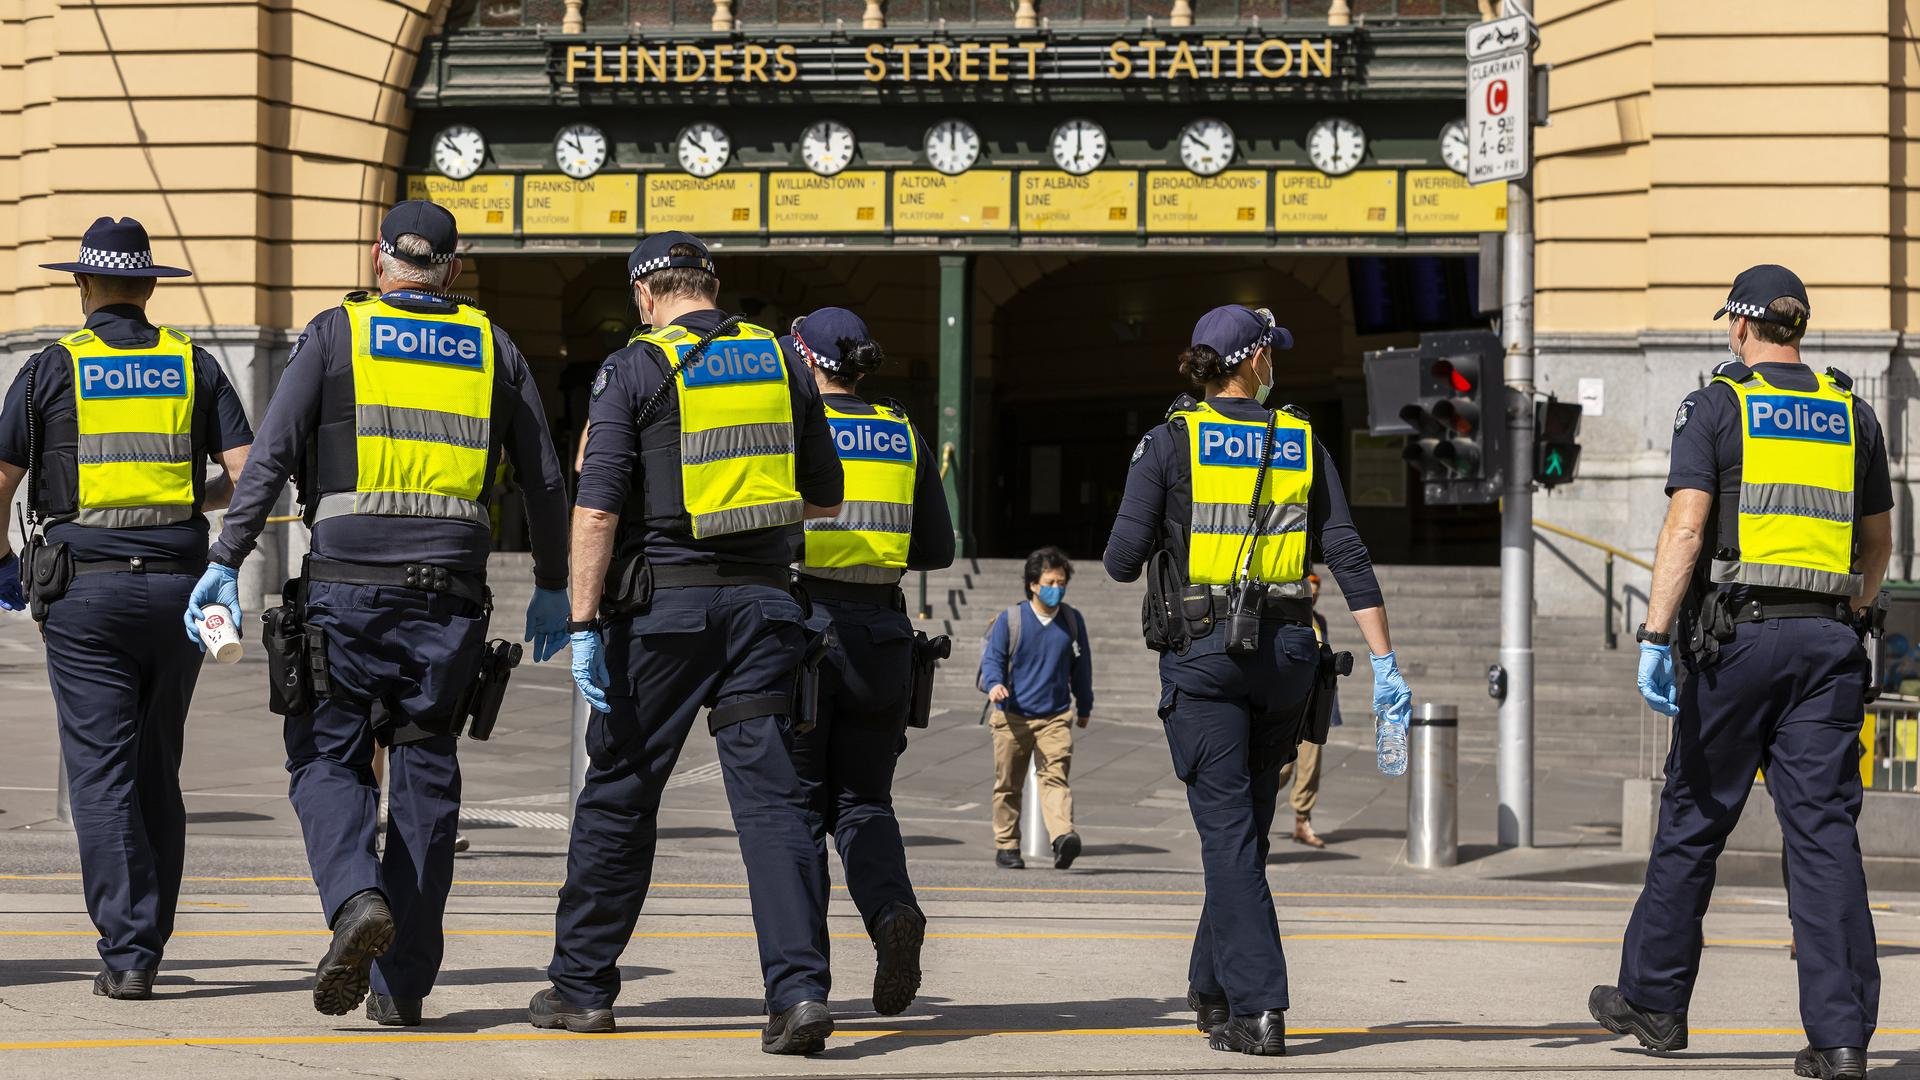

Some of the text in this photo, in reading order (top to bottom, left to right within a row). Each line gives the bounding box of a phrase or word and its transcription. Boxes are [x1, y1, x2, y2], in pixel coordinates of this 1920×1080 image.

[566, 39, 1333, 84] FLINDERS STREET STATION
[1472, 59, 1521, 80] CLEARWAY
[1475, 163, 1493, 176] MON
[1504, 159, 1520, 172] FRI
[471, 183, 488, 193] and
[527, 181, 595, 193] FRANKSTON
[651, 179, 736, 191] SANDRINGHAM
[777, 178, 865, 190] WILLIAMSTOWN
[901, 176, 946, 188] ALTONA
[1026, 177, 1089, 188] ST ALBANS
[1153, 177, 1256, 189] BROADMEADOWS
[1282, 177, 1332, 189] UPFIELD
[1413, 177, 1470, 188] WERRIBE
[482, 197, 511, 210] LINES
[527, 197, 551, 208] LINE
[651, 196, 675, 208] LINE
[776, 195, 800, 206] LINE
[900, 193, 925, 204] LINE
[1026, 194, 1051, 206] LINE
[1153, 194, 1178, 206] LINE
[1282, 194, 1308, 206] LINE
[1412, 194, 1439, 206] LINE
[375, 324, 477, 360] Police
[683, 347, 777, 379] Police
[83, 363, 181, 390] Police
[1751, 402, 1846, 435] Police
[1203, 430, 1302, 461] Police
[286, 666, 298, 687] 3
